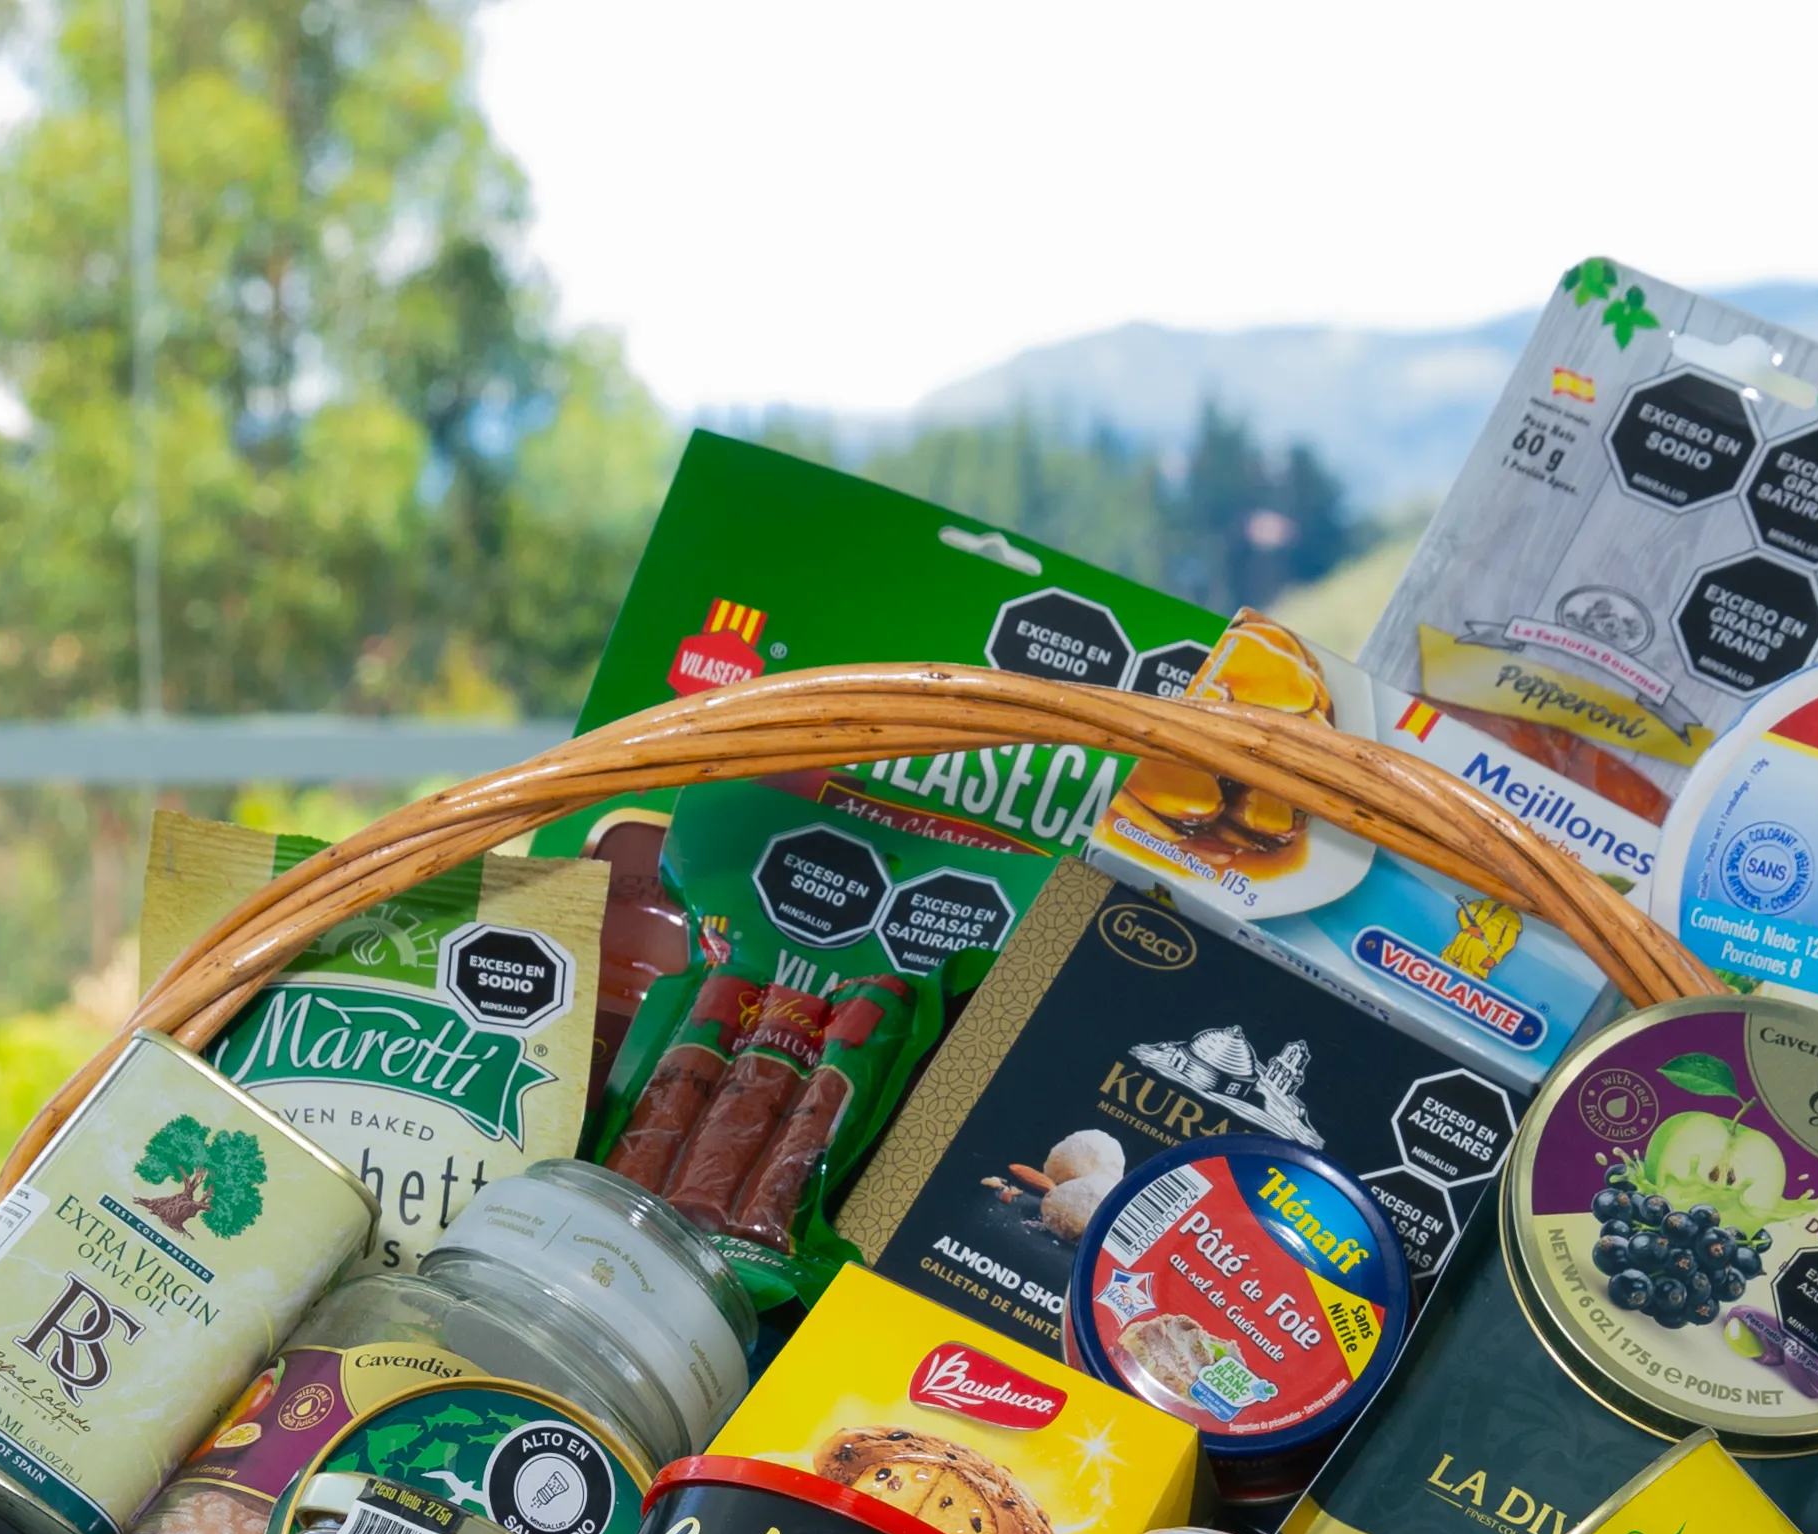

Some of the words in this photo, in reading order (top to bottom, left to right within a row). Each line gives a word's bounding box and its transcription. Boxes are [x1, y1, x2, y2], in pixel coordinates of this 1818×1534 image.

[1512, 428, 1546, 456] 60
[1545, 449, 1565, 473] g
[1639, 402, 1710, 448] EXCESO
[1713, 432, 1742, 457] EN
[1644, 430, 1714, 471] SODIO
[1705, 583, 1780, 626] EXCESO
[1780, 613, 1808, 639] EN
[1709, 605, 1785, 650] GRASAS
[1016, 620, 1082, 661] EXCESO
[1086, 642, 1111, 666] EN
[1027, 641, 1089, 677] SODIO
[1708, 623, 1771, 663] TRANS
[1495, 664, 1647, 740] Pepperoni
[1462, 752, 1655, 877] Mejillones
[783, 853, 844, 887] EXCESO
[846, 879, 870, 899] EN
[791, 874, 846, 908] SODIO
[1747, 858, 1787, 881] SANS
[779, 902, 832, 932] MINSALUD
[910, 893, 973, 920] EXCESO
[973, 908, 997, 923] EN
[910, 910, 984, 938] GRASAS
[1690, 907, 1761, 943] Contenido
[1764, 926, 1802, 953] Neto:
[1113, 909, 1185, 962] Greco
[470, 954, 522, 977] EXCESO
[525, 961, 545, 978] EN
[477, 970, 534, 994] SODIO
[1721, 943, 1788, 974] Porciones
[1789, 959, 1801, 978] 8
[479, 1000, 528, 1015] MINSALUD
[1379, 940, 1523, 1035] VIGILANTE
[1601, 1074, 1631, 1088] with
[1633, 1082, 1652, 1108] real
[1408, 1107, 1493, 1162] AZÚCARES
[1423, 1096, 1470, 1132] EXCESO
[1471, 1124, 1498, 1146] EN
[1411, 1145, 1458, 1177] MINSALUD
[101, 1194, 132, 1218] FIRST
[135, 1219, 163, 1243] COLD
[163, 1239, 214, 1283] PRESSED
[1258, 1167, 1370, 1274] Hénaff
[55, 1194, 133, 1264] EXTRA
[133, 1247, 220, 1327] VIRGIN
[78, 1241, 135, 1289] OLIVE
[135, 1285, 167, 1318] OIL
[932, 1235, 1017, 1293] ALMOND
[1180, 1212, 1249, 1278] Pâté
[1240, 1277, 1264, 1301] de
[1266, 1294, 1322, 1350] Foie
[920, 1256, 987, 1298] GALLETAS
[990, 1296, 1011, 1312] DE
[1329, 1302, 1358, 1354] Nitrite
[1351, 1305, 1375, 1341] Sans
[1549, 1228, 1572, 1261] NET
[1562, 1262, 1587, 1292] WT
[1579, 1295, 1589, 1308] 6
[1589, 1309, 1615, 1333] OZ
[1684, 1375, 1742, 1403] POIDS
[1747, 1390, 1784, 1406] NET
[923, 1351, 1051, 1414] Bauducco
[1214, 1364, 1250, 1396] BLANC
[33, 1388, 91, 1432] Salgado
[521, 1432, 563, 1453] ALTO
[567, 1436, 590, 1461] EN
[12, 1455, 48, 1484] SPAIN
